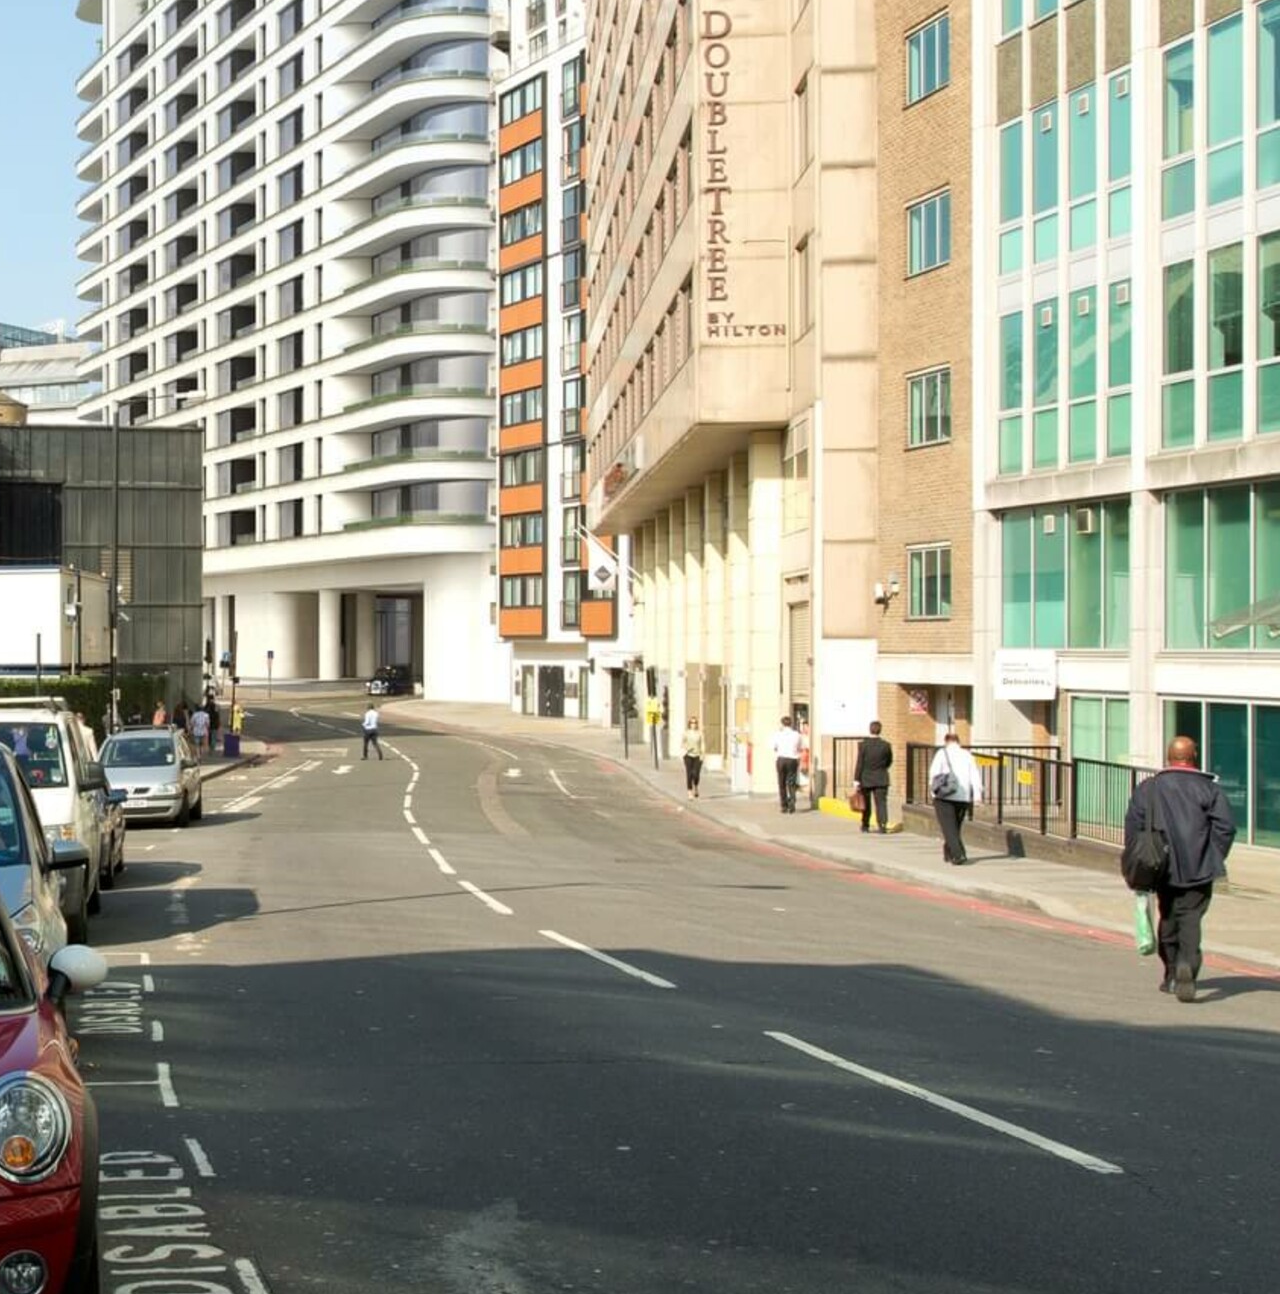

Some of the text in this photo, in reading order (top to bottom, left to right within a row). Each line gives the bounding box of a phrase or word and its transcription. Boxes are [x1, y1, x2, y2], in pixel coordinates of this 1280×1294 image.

[702, 10, 732, 301] DOUBLETREE
[707, 312, 734, 324] BY
[707, 324, 786, 338] HILTON
